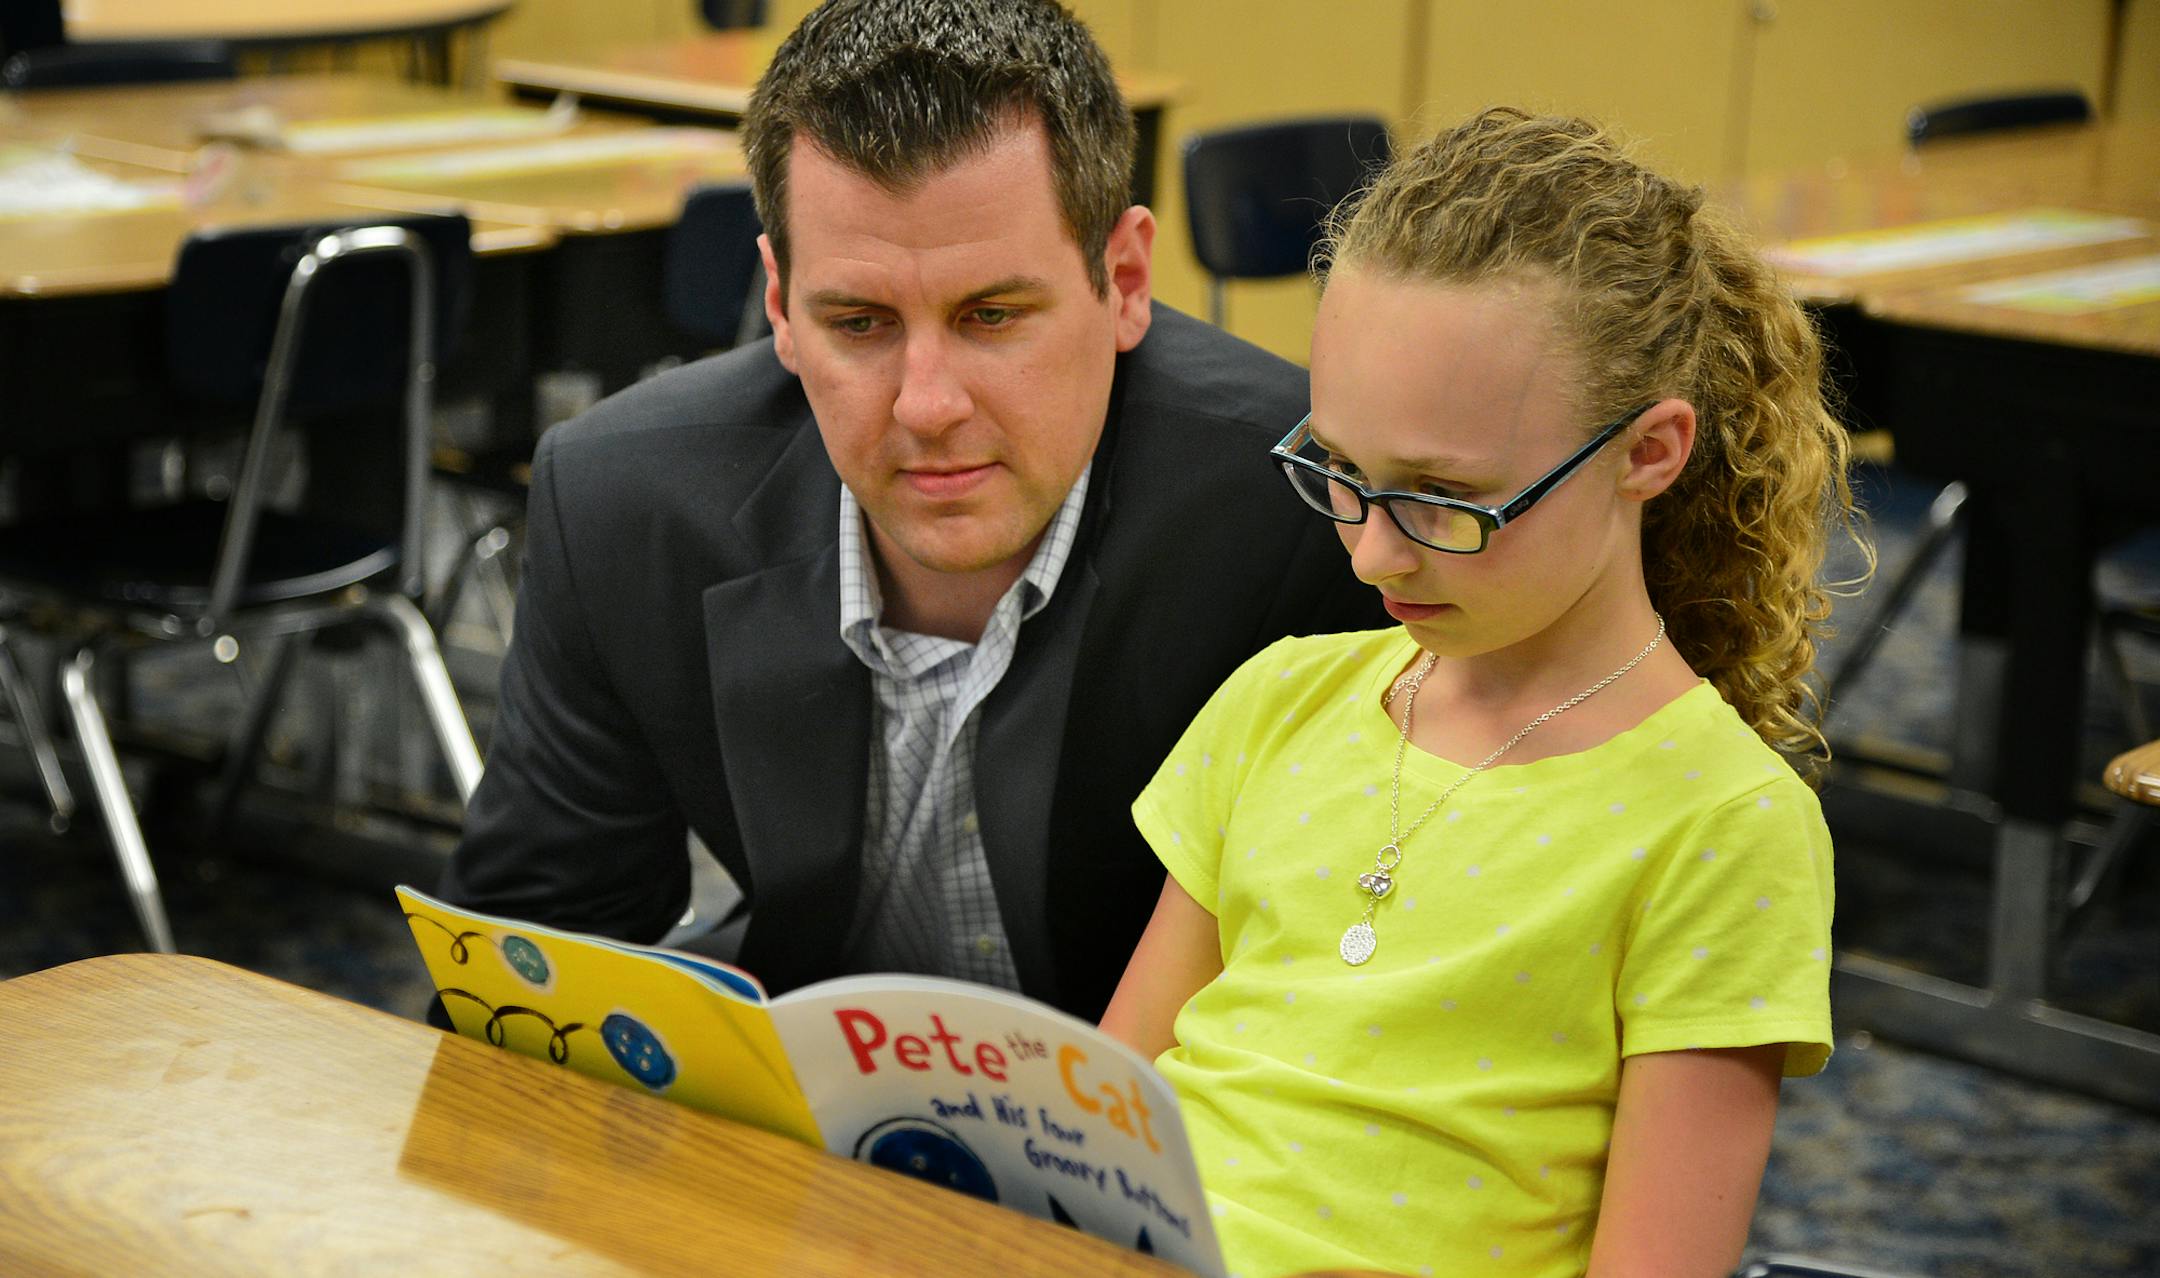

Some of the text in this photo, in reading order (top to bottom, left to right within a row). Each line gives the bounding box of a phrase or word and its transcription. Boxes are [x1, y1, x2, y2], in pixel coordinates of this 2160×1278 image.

[834, 1009, 1162, 1154] Pete the Cat
[930, 1092, 985, 1121] and
[990, 1094, 1028, 1128] His
[1024, 1138, 1106, 1192] Groovy
